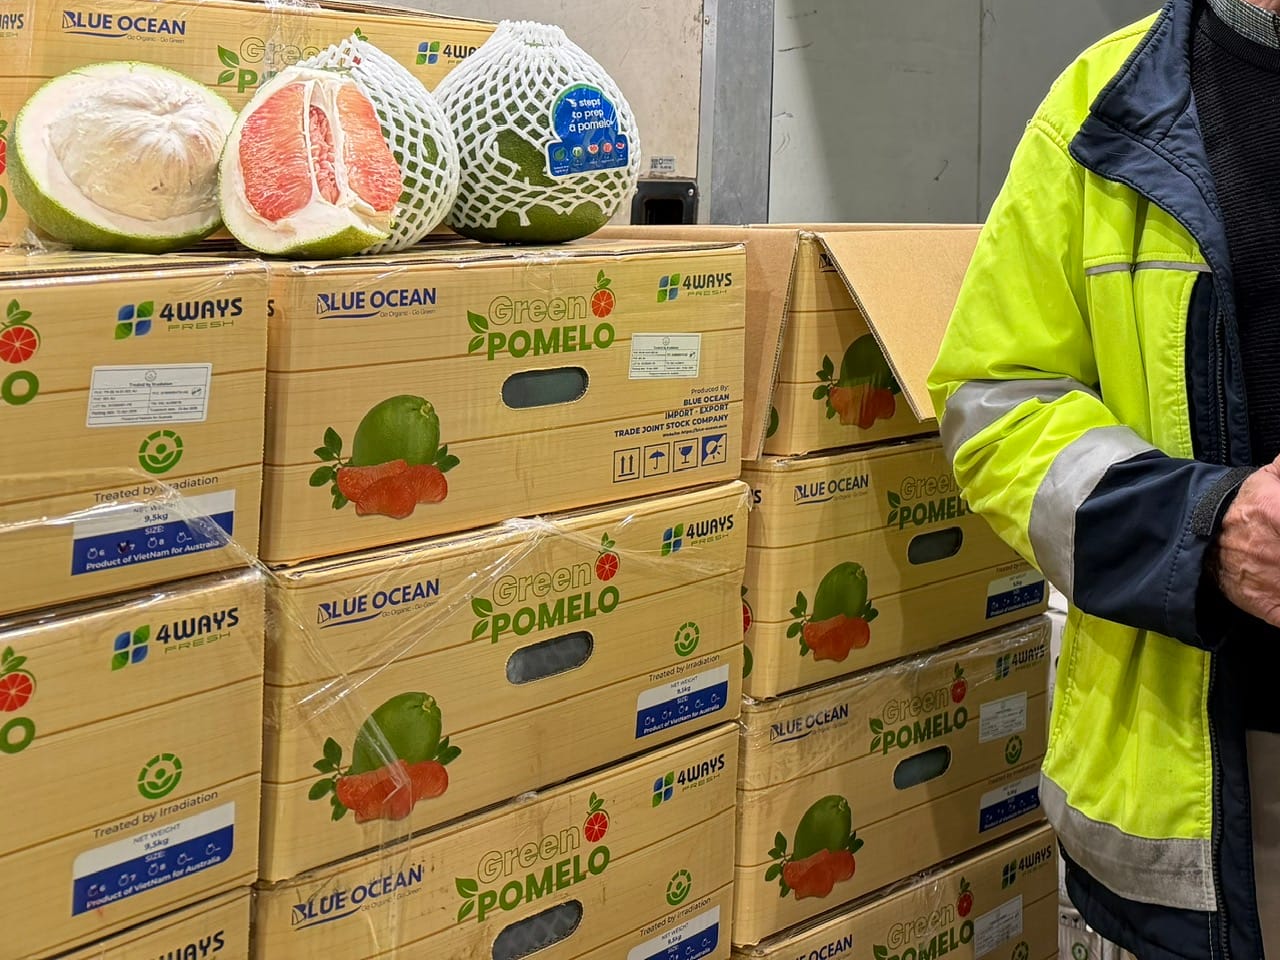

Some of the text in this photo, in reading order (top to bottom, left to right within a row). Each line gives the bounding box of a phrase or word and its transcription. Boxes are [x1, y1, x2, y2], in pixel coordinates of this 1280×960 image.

[62, 10, 187, 36] BLUE OCEAN
[572, 109, 604, 120] to prep
[682, 272, 733, 290] 4WAYS
[159, 297, 243, 322] 4WAYS
[316, 288, 437, 315] BLUE OCEAN
[488, 295, 587, 326] Green
[167, 320, 235, 332] FRESH
[487, 322, 615, 361] POMELO
[684, 393, 730, 406] BLUE OCEAN
[691, 385, 719, 395] Produced
[614, 428, 641, 438] TRADE
[642, 423, 665, 434] JOINT
[666, 419, 690, 430] STOCK
[692, 414, 729, 426] COMPANY
[665, 408, 693, 420] IMPORT
[700, 403, 729, 414] EXPORT
[94, 486, 140, 503] Treated
[143, 486, 158, 498] by
[794, 483, 825, 502] BLUE
[828, 474, 869, 492] OCEAN
[686, 514, 734, 539] 4WAYS
[86, 540, 220, 571] Product of VietNam for Australia
[130, 543, 136, 551] 7
[492, 560, 592, 607] Green
[317, 578, 440, 625] BLUE OCEAN
[490, 585, 620, 644] POMELO
[156, 607, 239, 645] 4WAYS
[164, 631, 231, 655] FRESH
[1012, 644, 1045, 667] 4WAYS
[648, 653, 720, 683] Treated by Irradiation
[882, 687, 949, 726] Green
[770, 718, 802, 742] BLUE
[805, 703, 849, 728] OCEAN
[882, 706, 968, 756] POMELO
[677, 753, 725, 786] 4WAYS
[93, 791, 219, 840] Treated by Irradiation
[133, 823, 181, 844] NET WEIGHT
[477, 825, 581, 885] Green
[1018, 844, 1052, 872] 4WAYS
[86, 891, 126, 909] Product
[124, 884, 134, 896] of
[172, 868, 185, 879] for
[185, 855, 221, 873] Australia
[129, 873, 137, 882] 7
[477, 844, 610, 923] POMELO
[292, 863, 422, 926] BLUE OCEAN
[639, 897, 711, 938] Treated by Irradiation
[886, 902, 955, 951] Green
